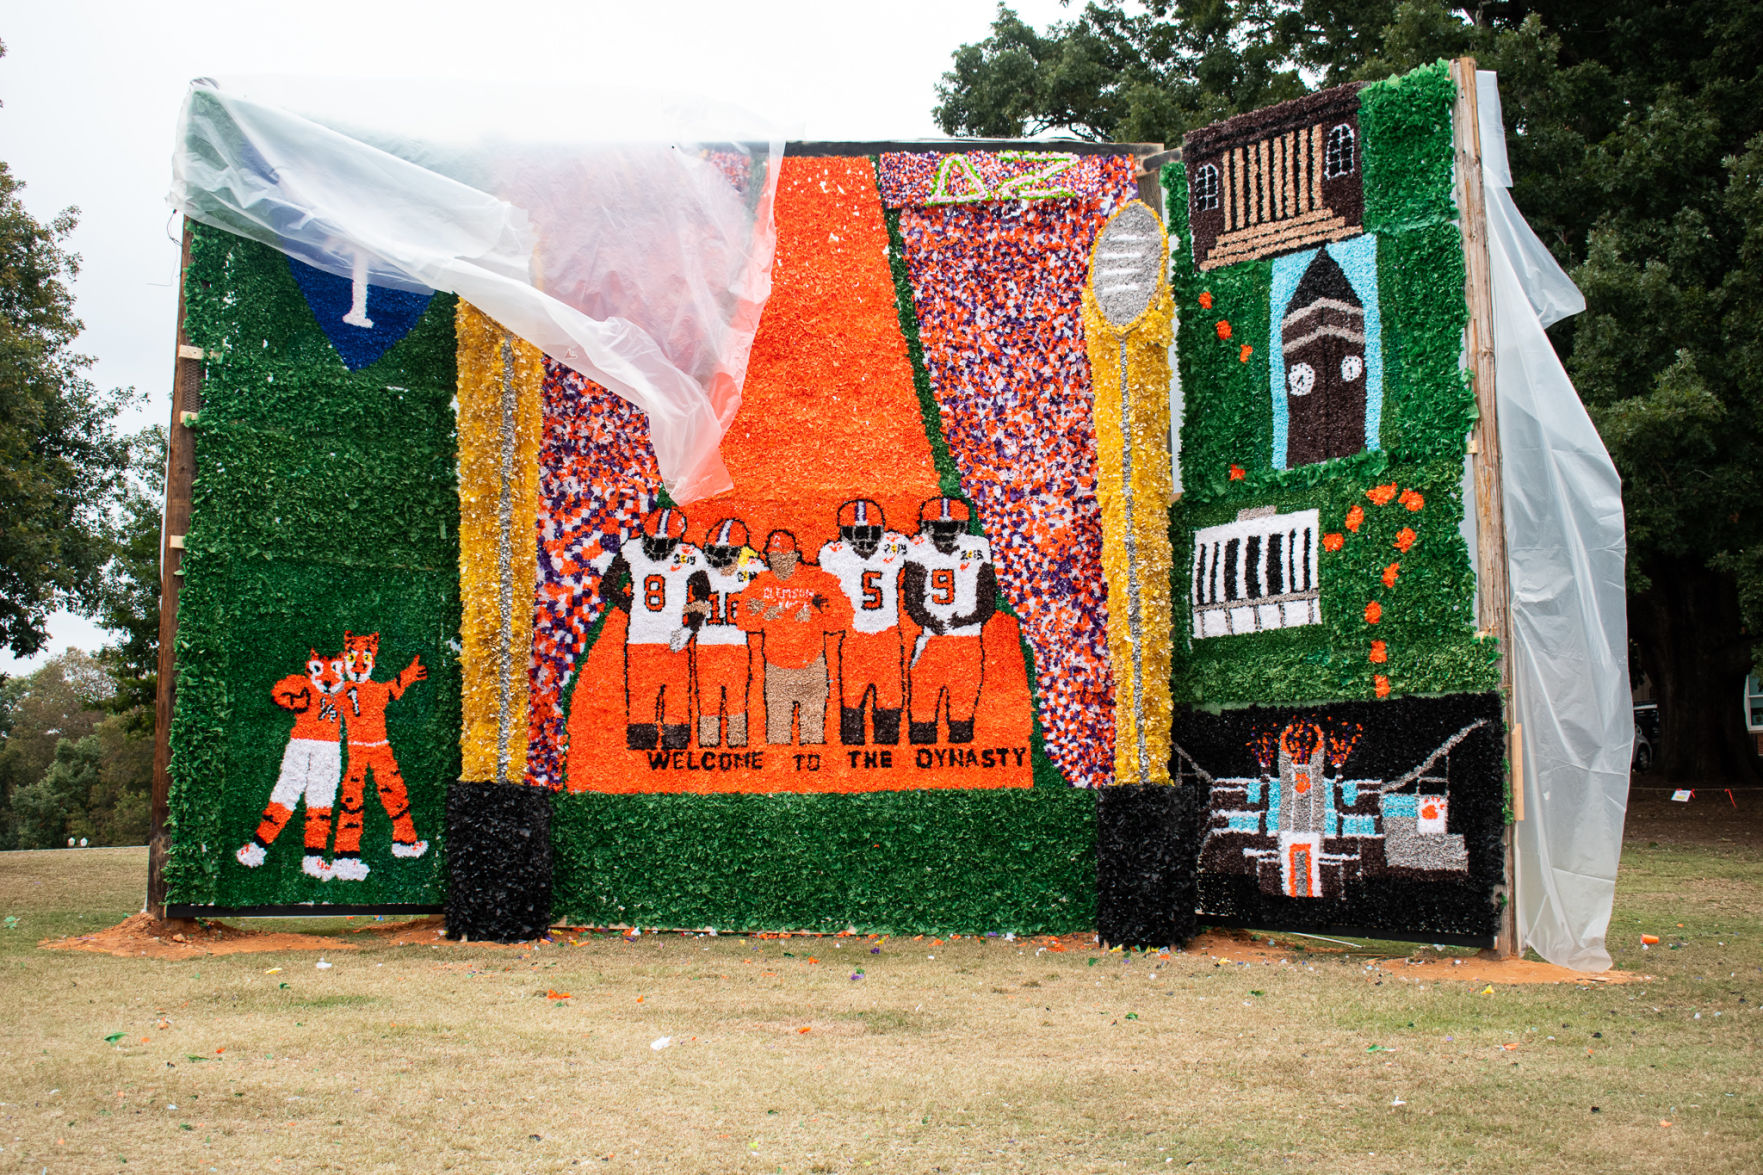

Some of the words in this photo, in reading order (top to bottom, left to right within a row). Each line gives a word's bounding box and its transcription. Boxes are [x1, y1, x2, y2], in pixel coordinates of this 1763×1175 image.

[644, 573, 666, 613] 8
[763, 586, 815, 600] CLEMSON
[861, 569, 883, 611] 5
[931, 568, 955, 605] 9
[647, 751, 764, 771] WELCOME
[792, 753, 821, 772] TO
[848, 750, 893, 769] THE
[916, 746, 1027, 769] DYNASTY
